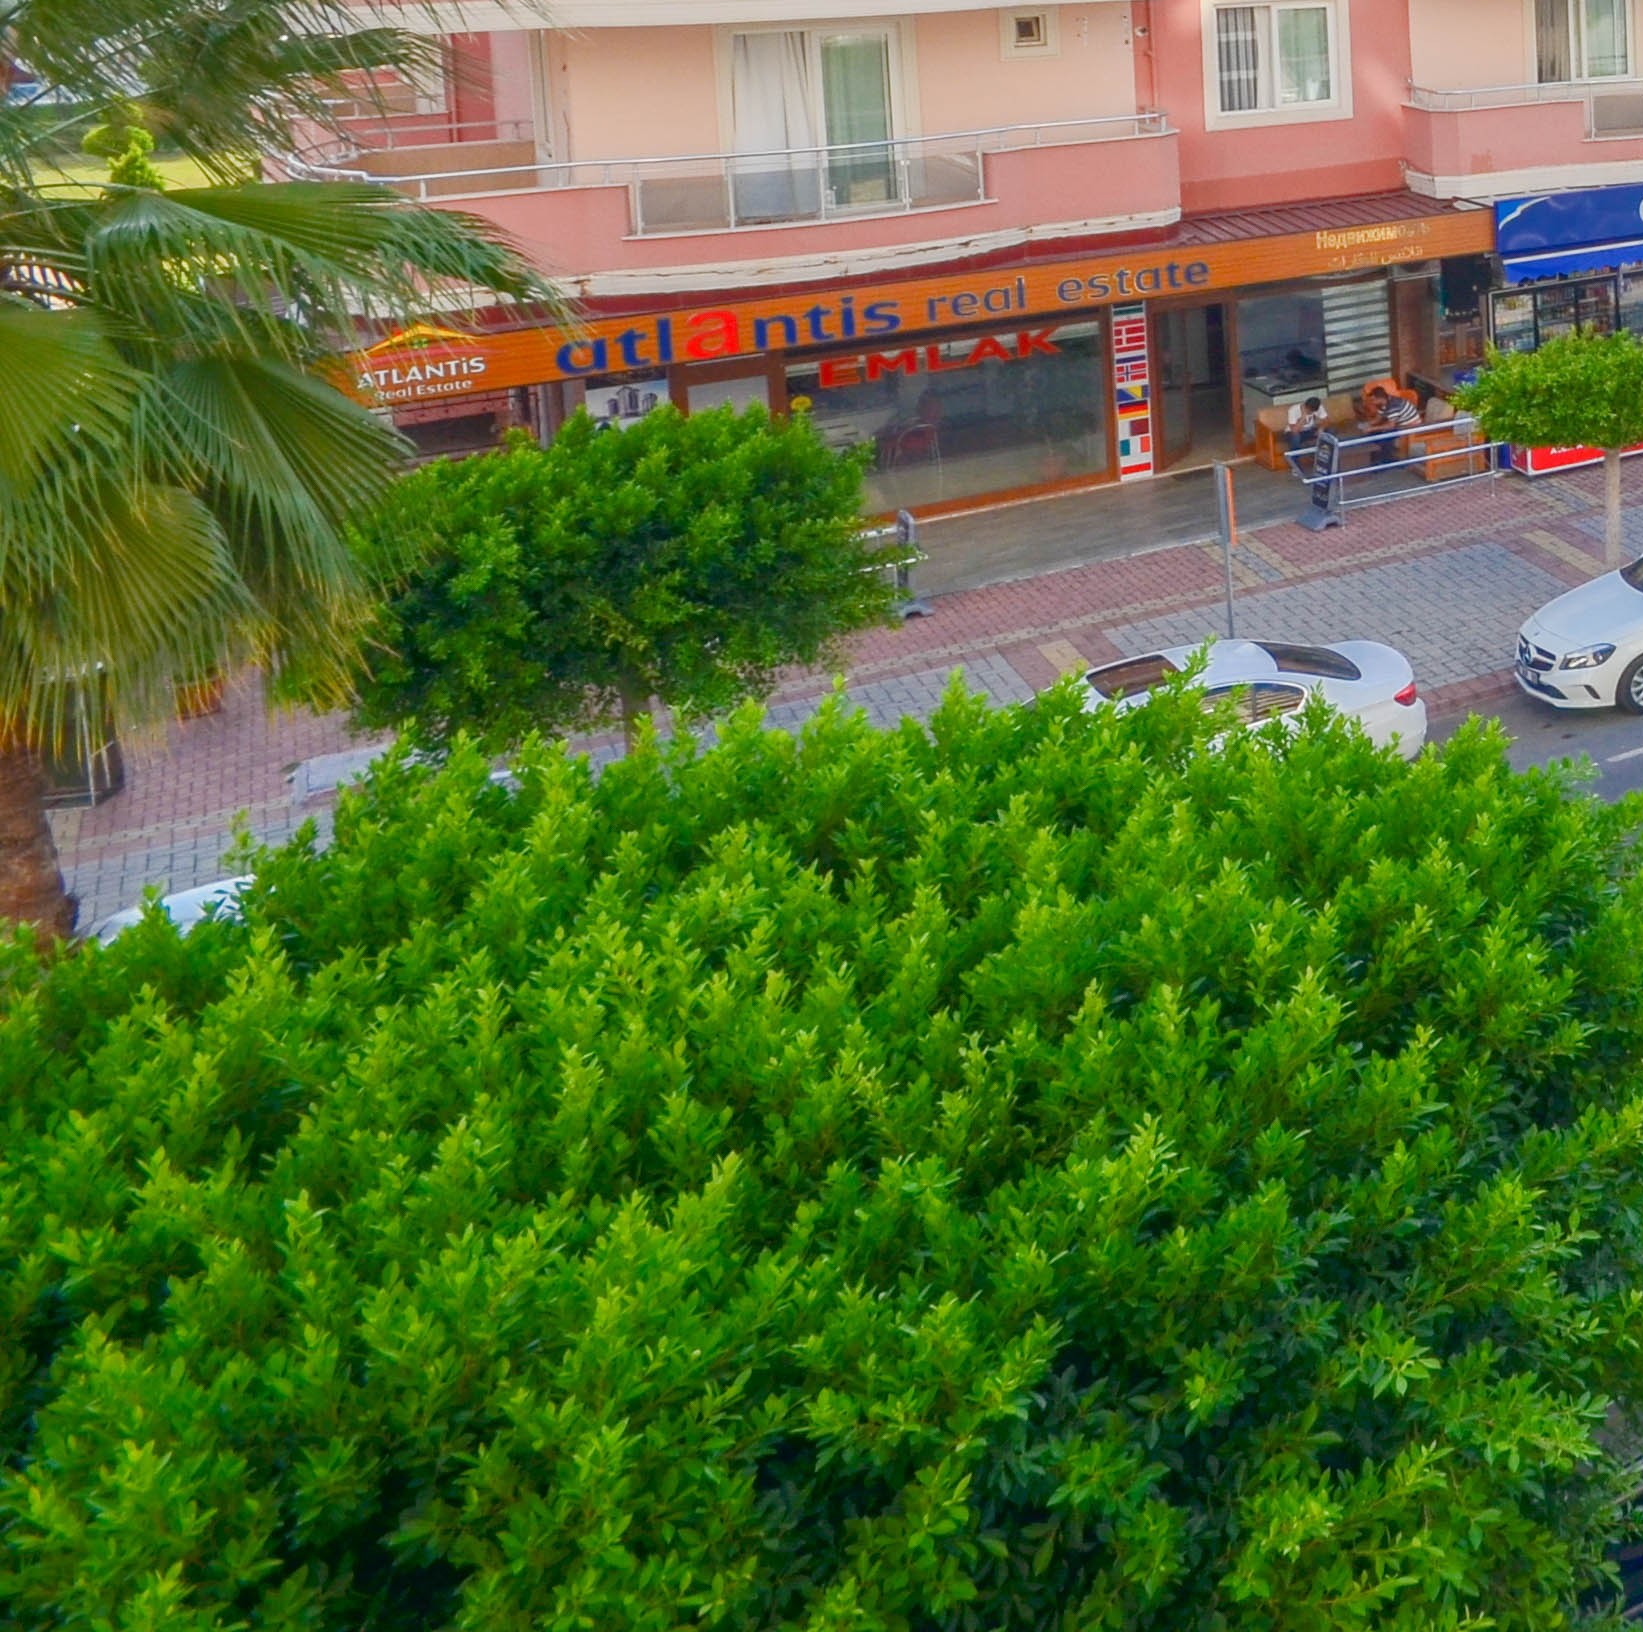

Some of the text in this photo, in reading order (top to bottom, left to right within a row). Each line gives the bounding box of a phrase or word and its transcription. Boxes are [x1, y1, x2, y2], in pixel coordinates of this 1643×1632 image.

[555, 258, 1210, 376] atlantis real estate
[818, 326, 1062, 389] EMLAK
[374, 378, 473, 401] Real Estate
